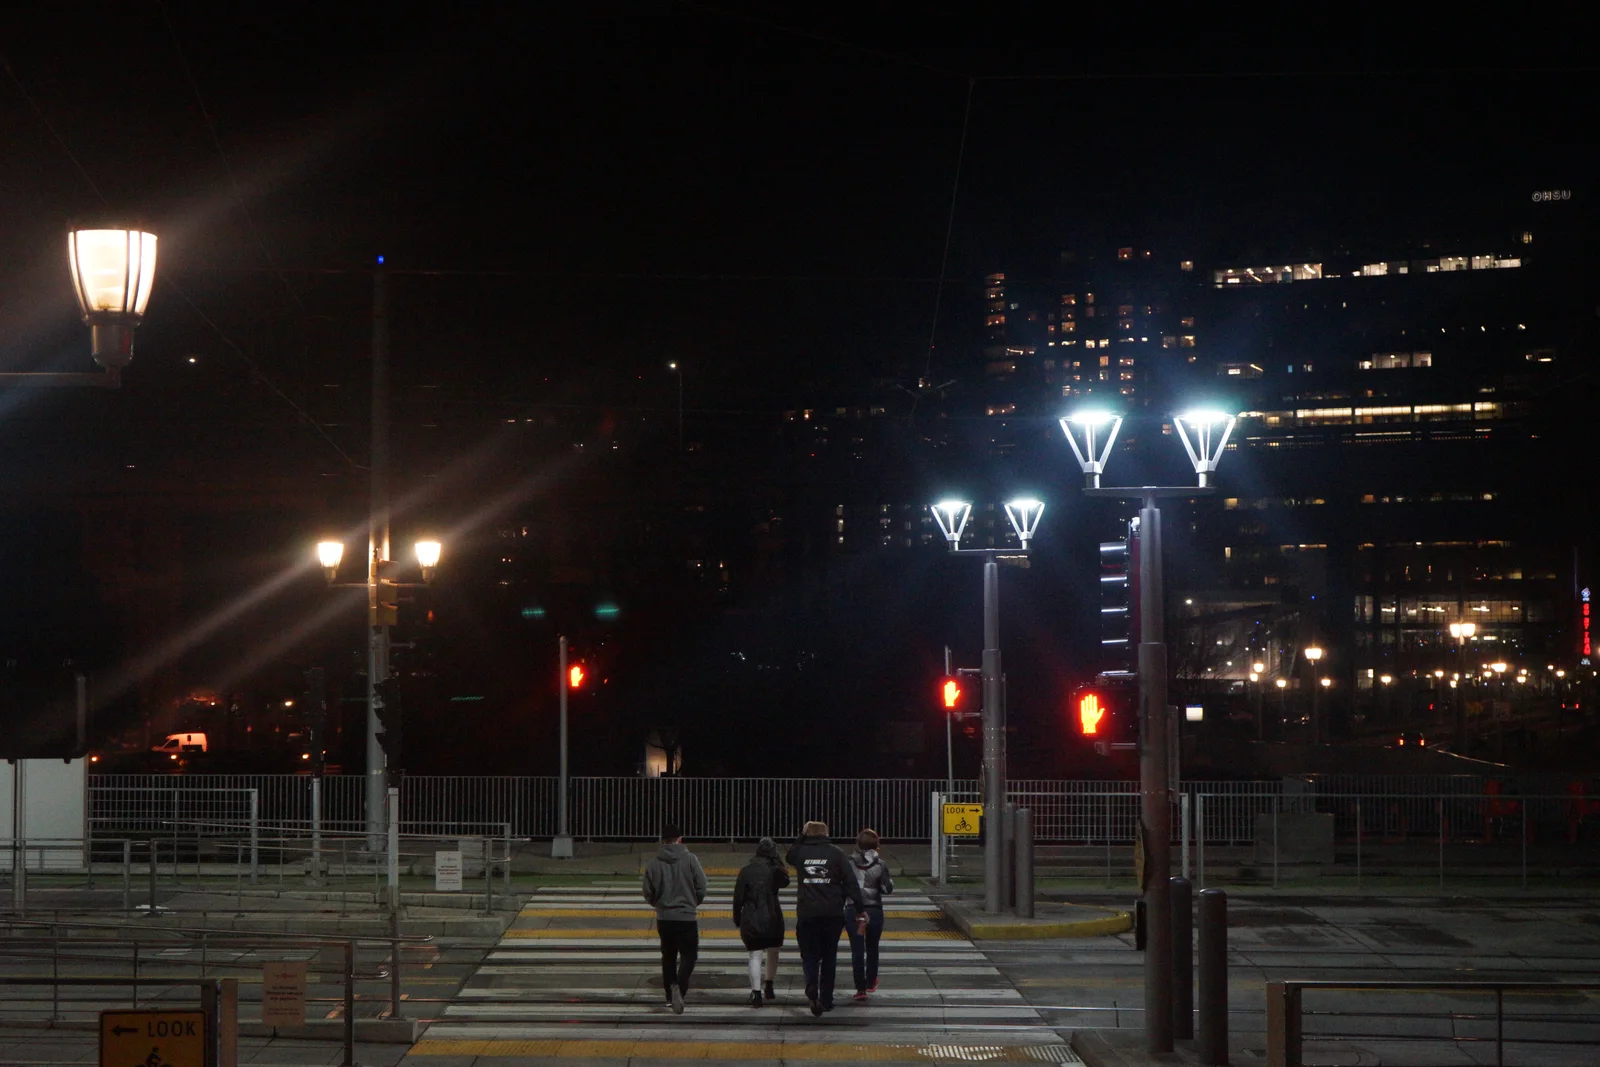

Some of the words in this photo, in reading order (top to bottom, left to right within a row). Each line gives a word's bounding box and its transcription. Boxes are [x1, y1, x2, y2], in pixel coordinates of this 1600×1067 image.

[1531, 190, 1572, 202] OHSU
[946, 807, 966, 815] LOOK
[147, 1020, 197, 1037] LOOK
